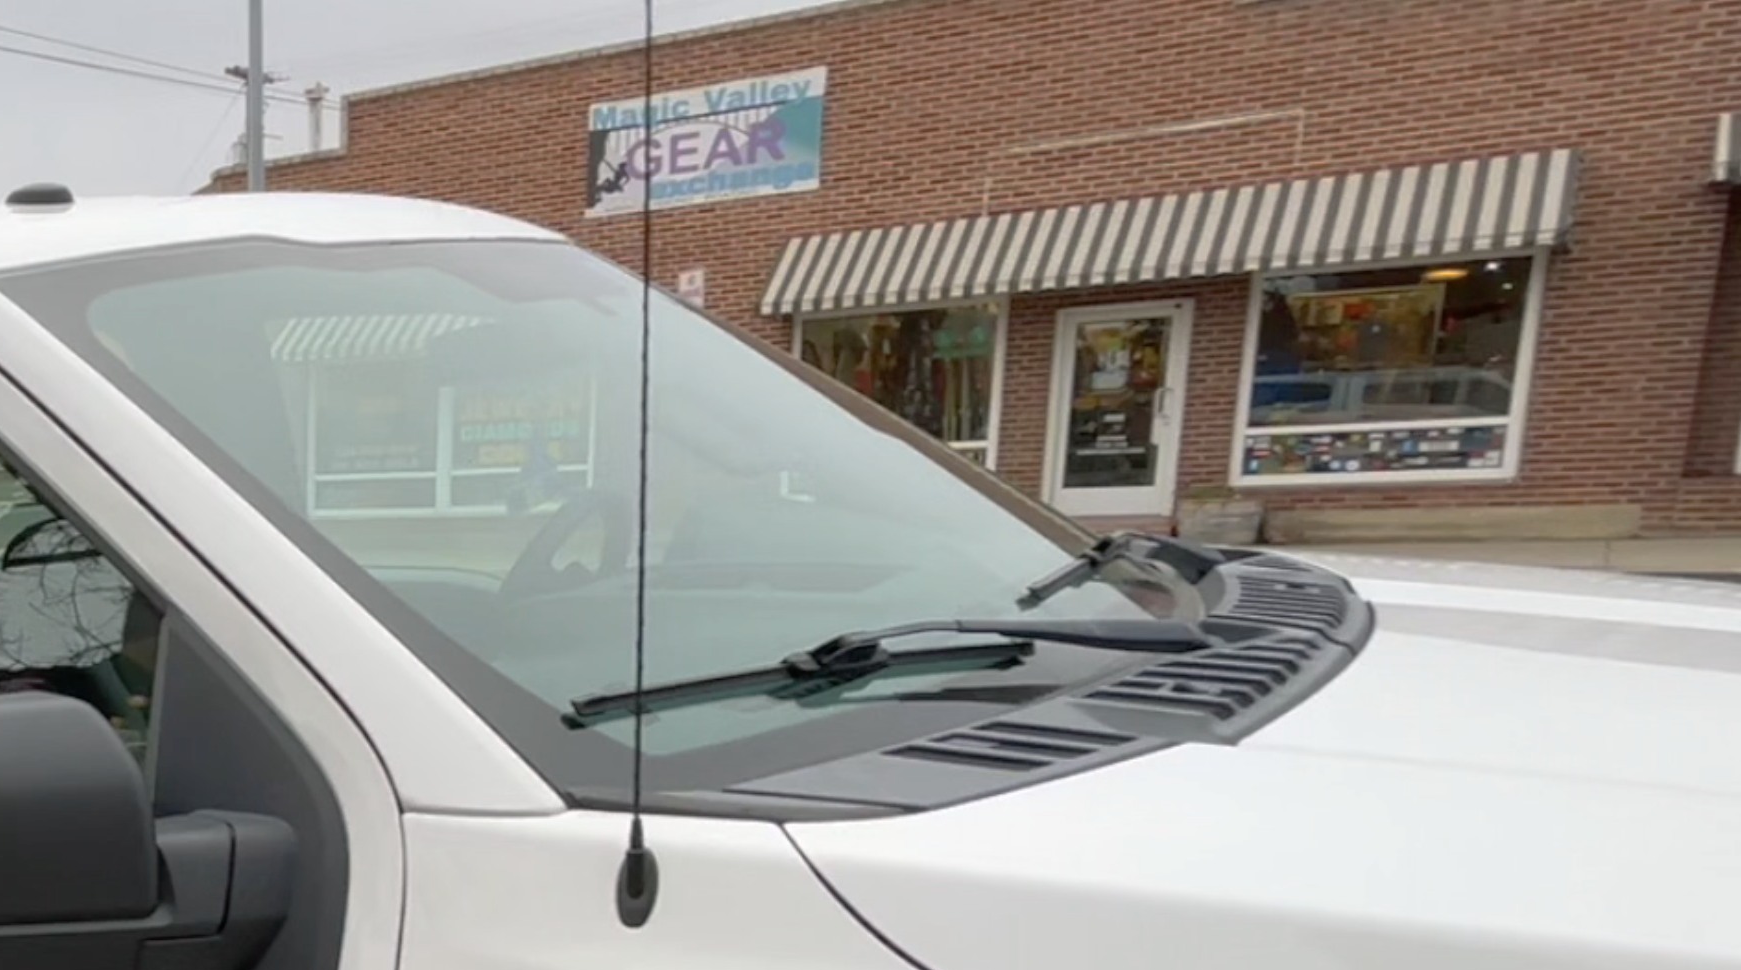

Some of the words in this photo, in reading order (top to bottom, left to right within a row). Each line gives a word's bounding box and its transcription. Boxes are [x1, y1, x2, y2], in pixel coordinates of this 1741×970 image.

[592, 96, 690, 132] Magic
[705, 79, 812, 112] Valley
[625, 114, 786, 180] GEAR
